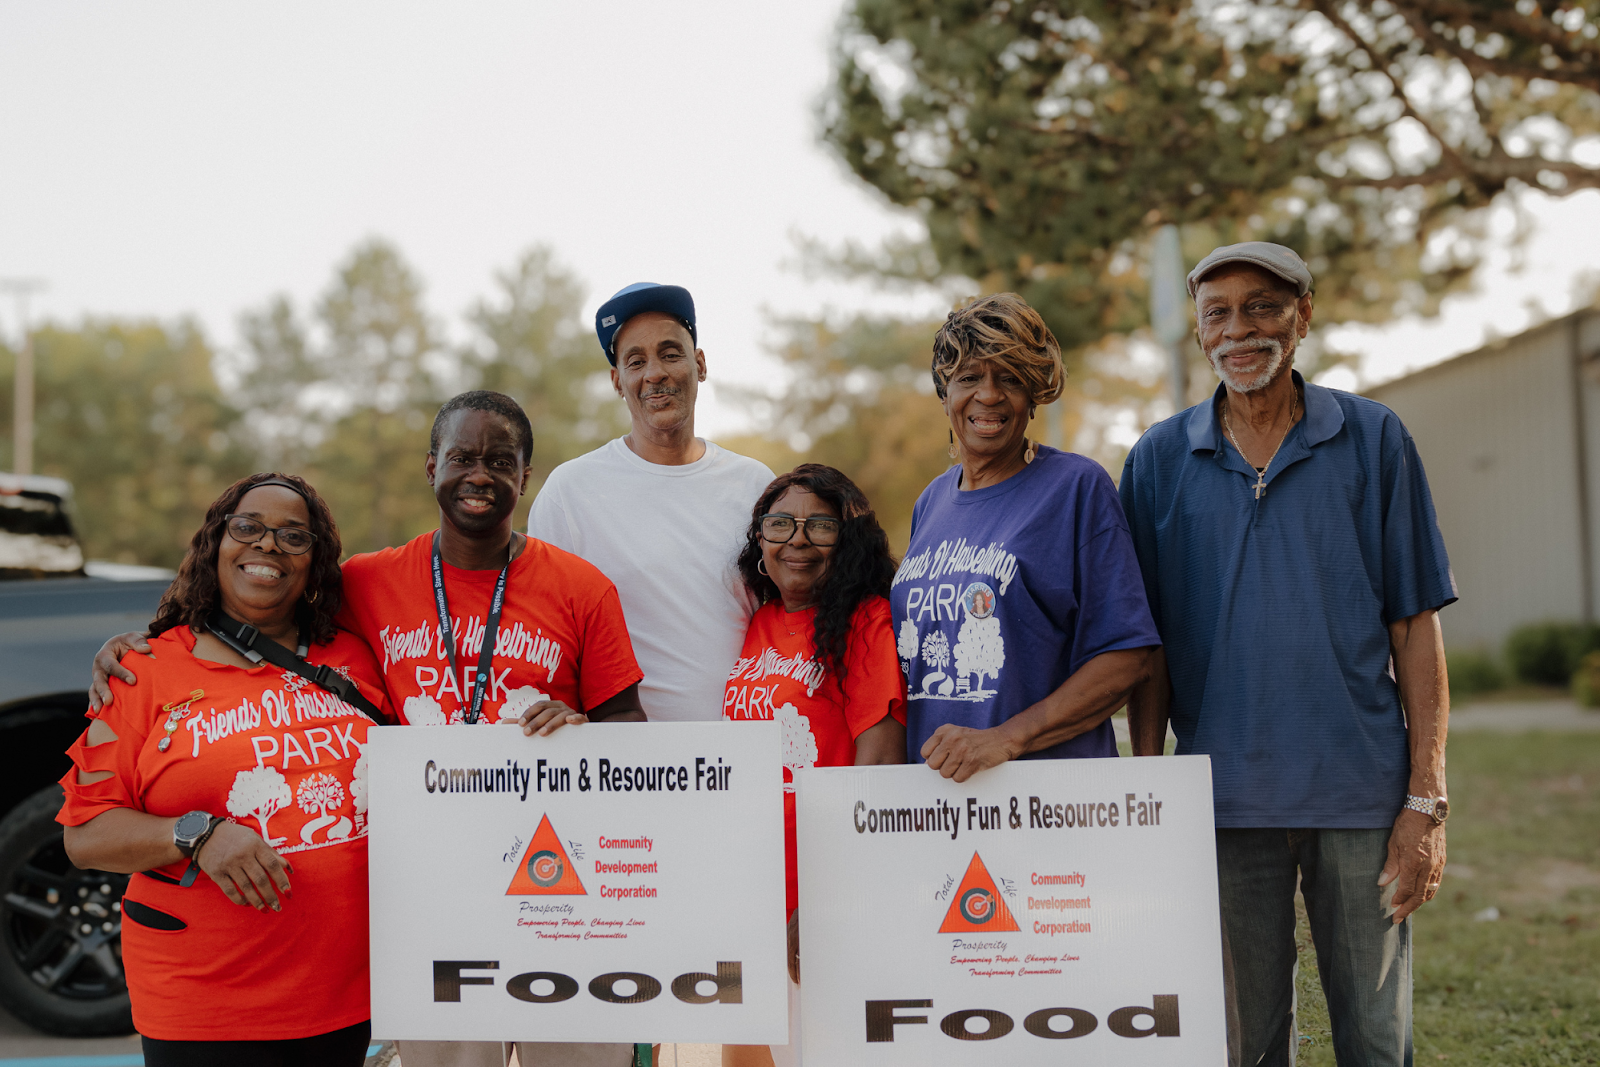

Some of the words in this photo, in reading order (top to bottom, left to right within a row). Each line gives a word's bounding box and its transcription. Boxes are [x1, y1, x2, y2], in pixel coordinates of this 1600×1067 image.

[434, 570, 442, 588] Starts
[492, 587, 504, 615] Possible.
[906, 583, 968, 621] PARK
[966, 584, 992, 600] HARRIS
[437, 588, 450, 634] Transformation
[379, 619, 435, 675] Friends
[461, 615, 563, 684] Haselbring
[416, 665, 512, 702] PARK
[723, 683, 780, 719] PARK
[186, 697, 262, 758] Friends
[261, 689, 291, 728] Of
[251, 723, 361, 770] PARK
[424, 759, 531, 802] Community
[537, 758, 570, 793] Fun
[578, 757, 592, 793] &
[599, 758, 688, 793] Resource
[695, 757, 732, 792] Fair
[854, 798, 960, 840] Community
[966, 797, 1001, 831] Fun
[1009, 796, 1022, 830] &
[1029, 795, 1119, 829] Resource
[1125, 792, 1162, 827] Fair
[503, 835, 523, 863] Total
[568, 840, 586, 861] Life
[598, 835, 653, 852] Community
[595, 860, 658, 876] Development
[935, 874, 955, 902] Total
[1000, 877, 1018, 898] Life
[1031, 871, 1086, 888] Community
[600, 884, 657, 901] Corporation
[519, 901, 574, 916] Prosperity
[1028, 895, 1091, 912] Development
[517, 918, 559, 928] Empowering
[590, 917, 624, 928] Changing
[625, 918, 646, 926] Lives
[1033, 919, 1091, 937] Corporation
[535, 930, 581, 941] Transforming
[583, 930, 628, 941] Communities
[952, 939, 1008, 953] Prosperity
[950, 955, 993, 966] Empowering
[1024, 954, 1058, 964] Changing
[1060, 953, 1080, 962] Lives
[432, 960, 744, 1005] Food
[968, 968, 1015, 979] Transforming
[1017, 967, 1063, 977] Communities
[865, 993, 1181, 1043] Food
